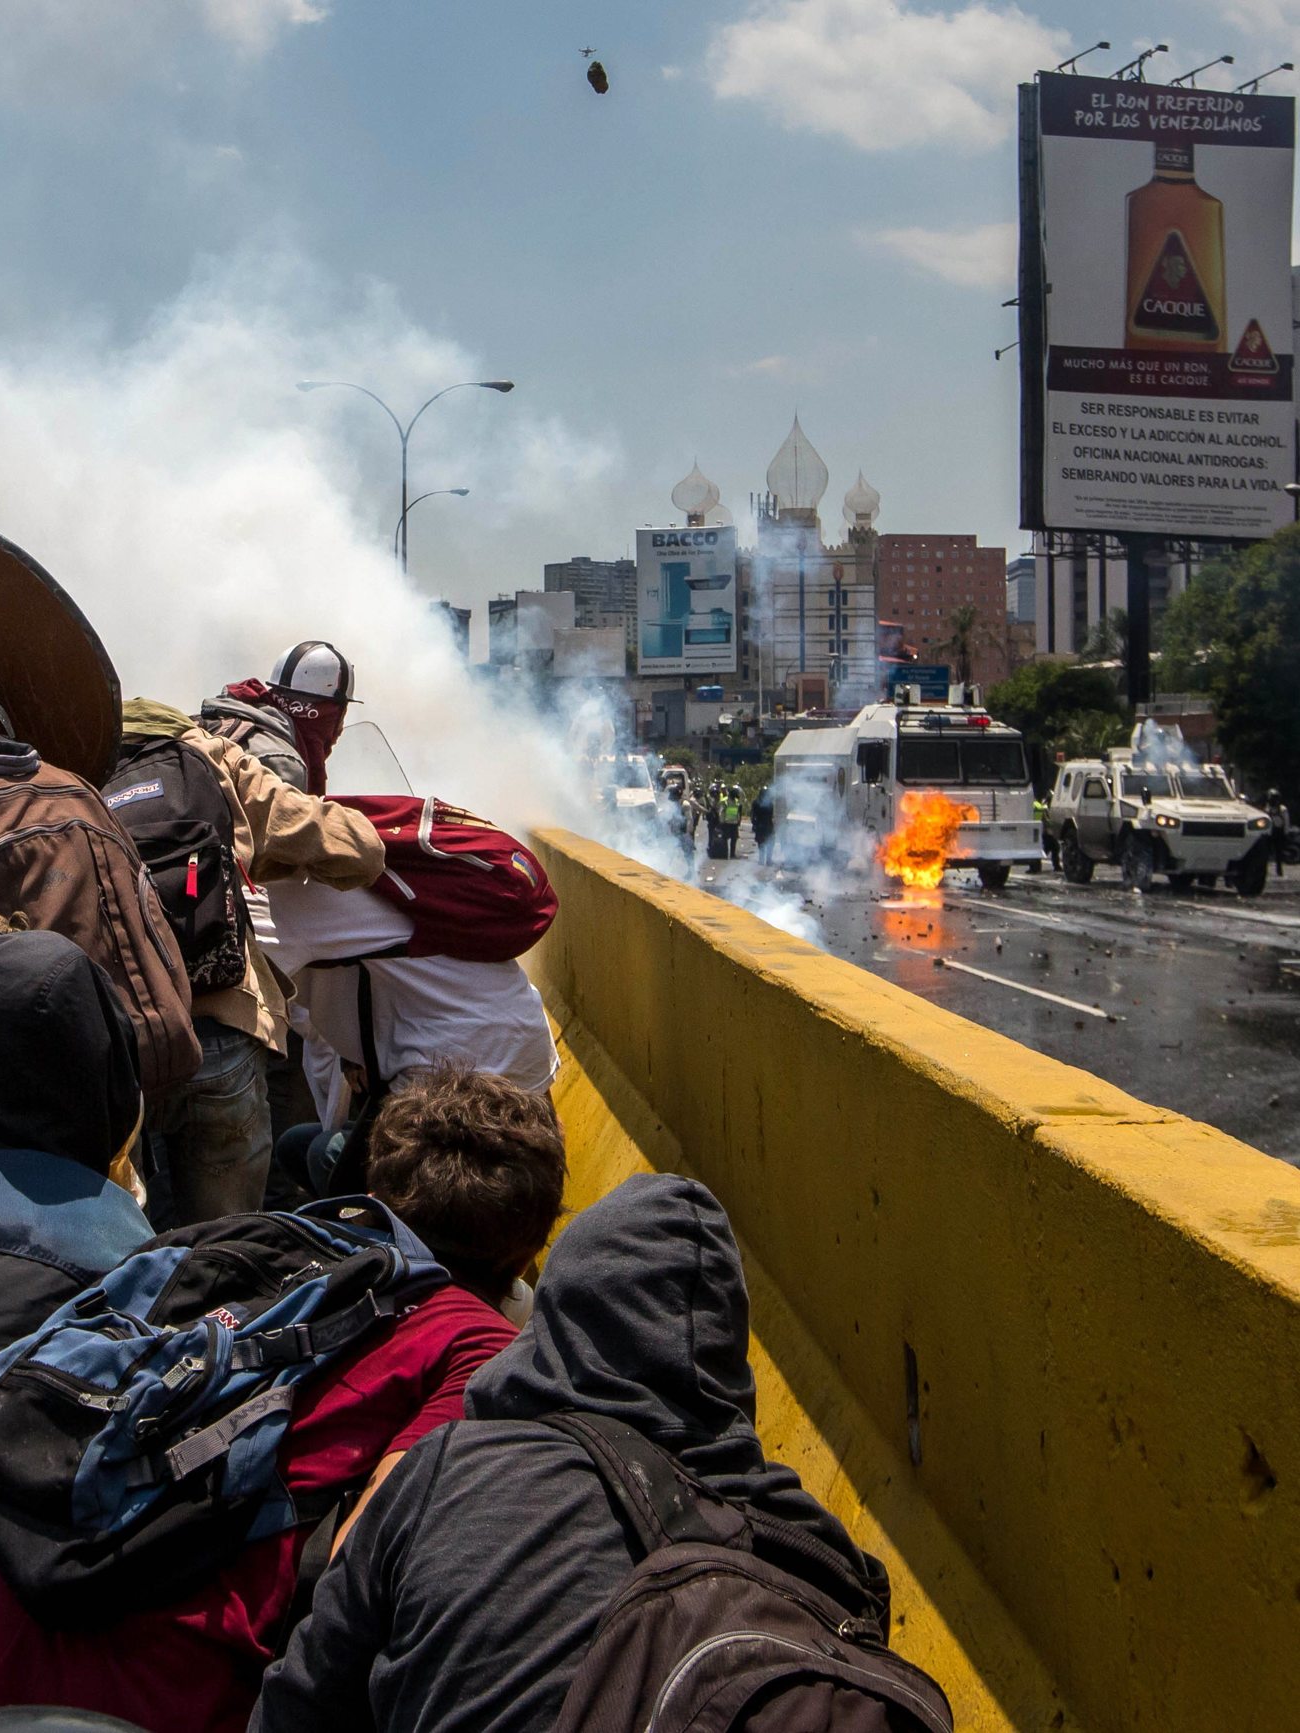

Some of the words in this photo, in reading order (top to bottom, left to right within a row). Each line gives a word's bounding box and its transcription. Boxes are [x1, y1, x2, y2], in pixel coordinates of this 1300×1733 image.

[1091, 94, 1111, 108] EL
[1116, 94, 1149, 110] RON
[1156, 94, 1244, 113] PREFERIDO
[1074, 110, 1106, 127] POR
[1112, 111, 1140, 128] LOS
[1143, 299, 1205, 317] CACIQUE
[1063, 358, 1105, 370] MUCHO
[1109, 357, 1133, 371] MÁS
[1137, 361, 1160, 372] QUE
[1164, 362, 1180, 372] UN
[1130, 373, 1141, 384] ES
[1146, 374, 1157, 385] EL
[1081, 402, 1105, 416] SER
[1108, 403, 1196, 422] RESPONSABLE
[1199, 410, 1214, 423] ES
[1217, 412, 1260, 425] EVITAR
[1053, 422, 1066, 435] EL
[1069, 423, 1117, 438] EXCESO
[1120, 427, 1128, 438] Y
[1131, 428, 1146, 440] LA
[1149, 429, 1205, 444] ADICCIÓN
[1208, 434, 1224, 445] AL
[1226, 435, 1287, 448] ALCOHOL.
[1073, 446, 1121, 461] OFICINA
[1124, 449, 1185, 465] NACIONAL
[1187, 454, 1268, 470] ANTIDROGAS:
[1061, 467, 1137, 484] SEMBRANDO
[1140, 473, 1195, 488] VALORES
[1198, 476, 1230, 489] PARA
[1232, 478, 1248, 490] LA
[1250, 480, 1282, 492] VIDA.
[651, 531, 718, 548] BACCO
